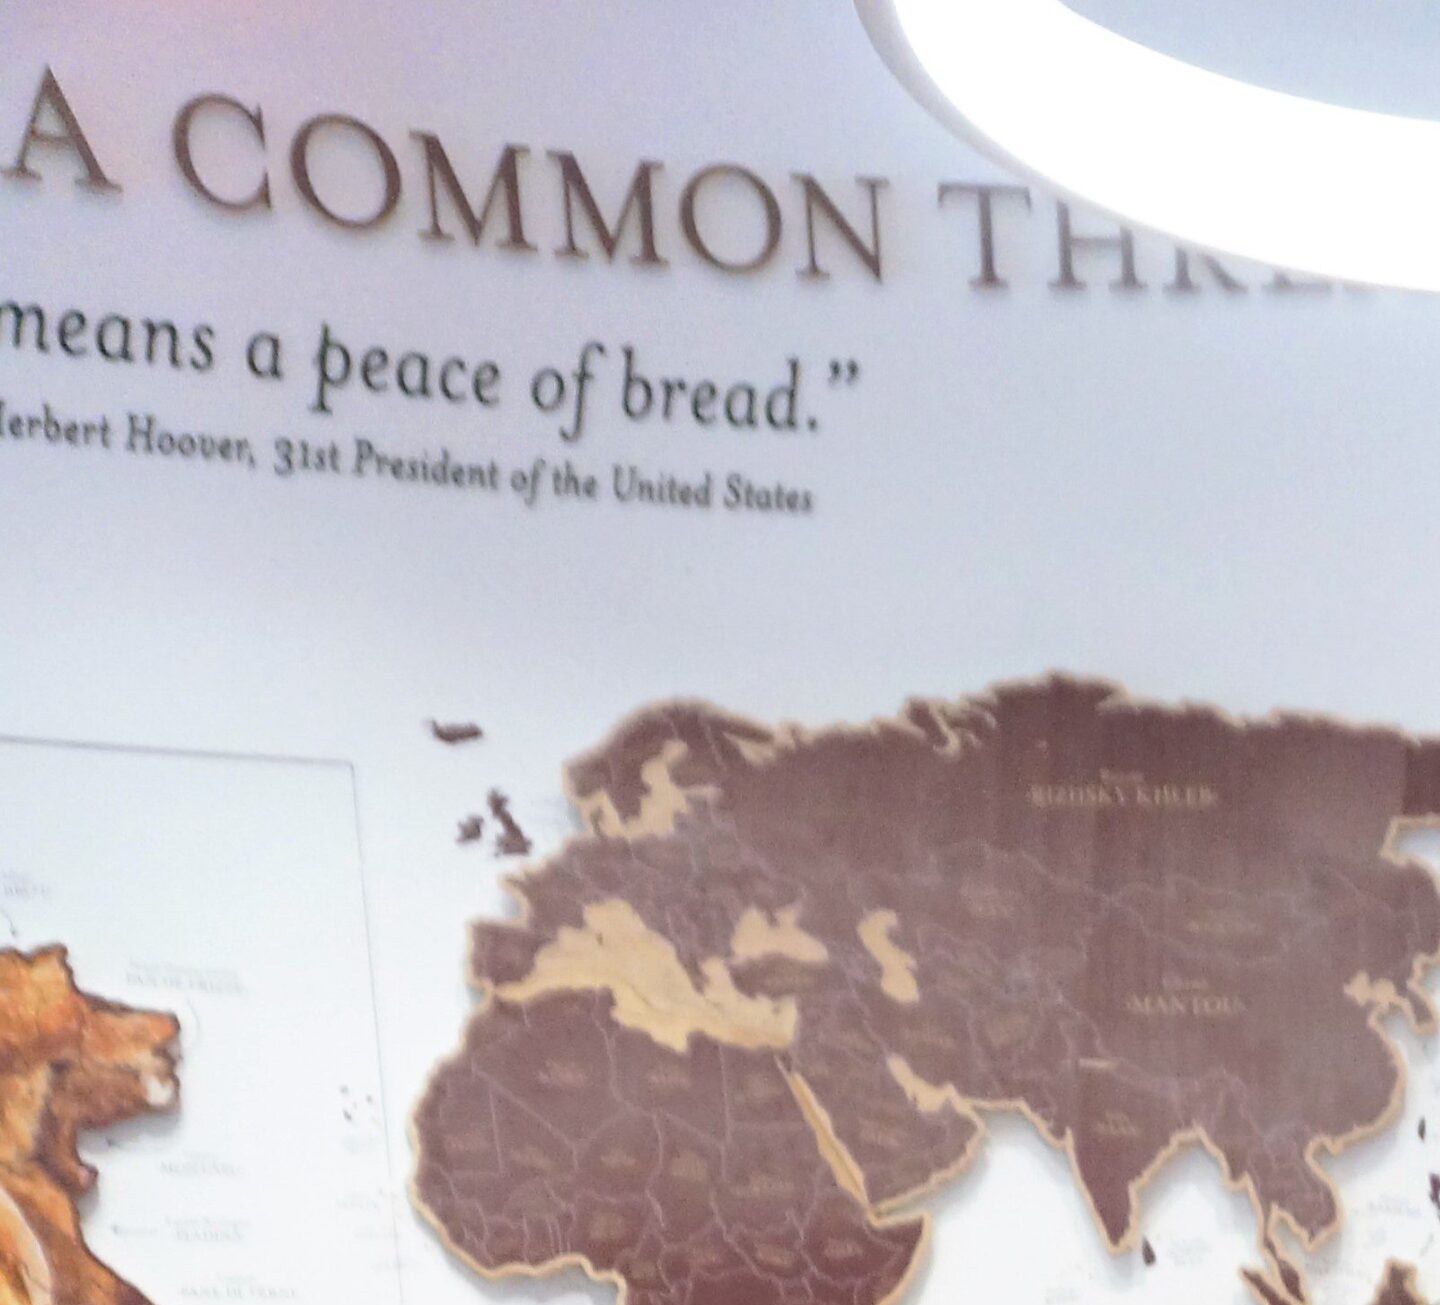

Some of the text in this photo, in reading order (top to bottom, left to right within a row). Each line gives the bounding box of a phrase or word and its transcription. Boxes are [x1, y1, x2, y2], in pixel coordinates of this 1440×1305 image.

[2, 64, 122, 193] A
[172, 92, 893, 285] COMMON
[0, 299, 215, 373] means
[246, 329, 283, 381] a
[309, 320, 500, 416] peace
[531, 341, 606, 444] of
[126, 411, 257, 470] Hoover,
[273, 436, 342, 478] 31st
[352, 437, 499, 492] President
[510, 457, 546, 511] of
[552, 460, 598, 500] the
[612, 462, 713, 509] United
[722, 471, 814, 514] States
